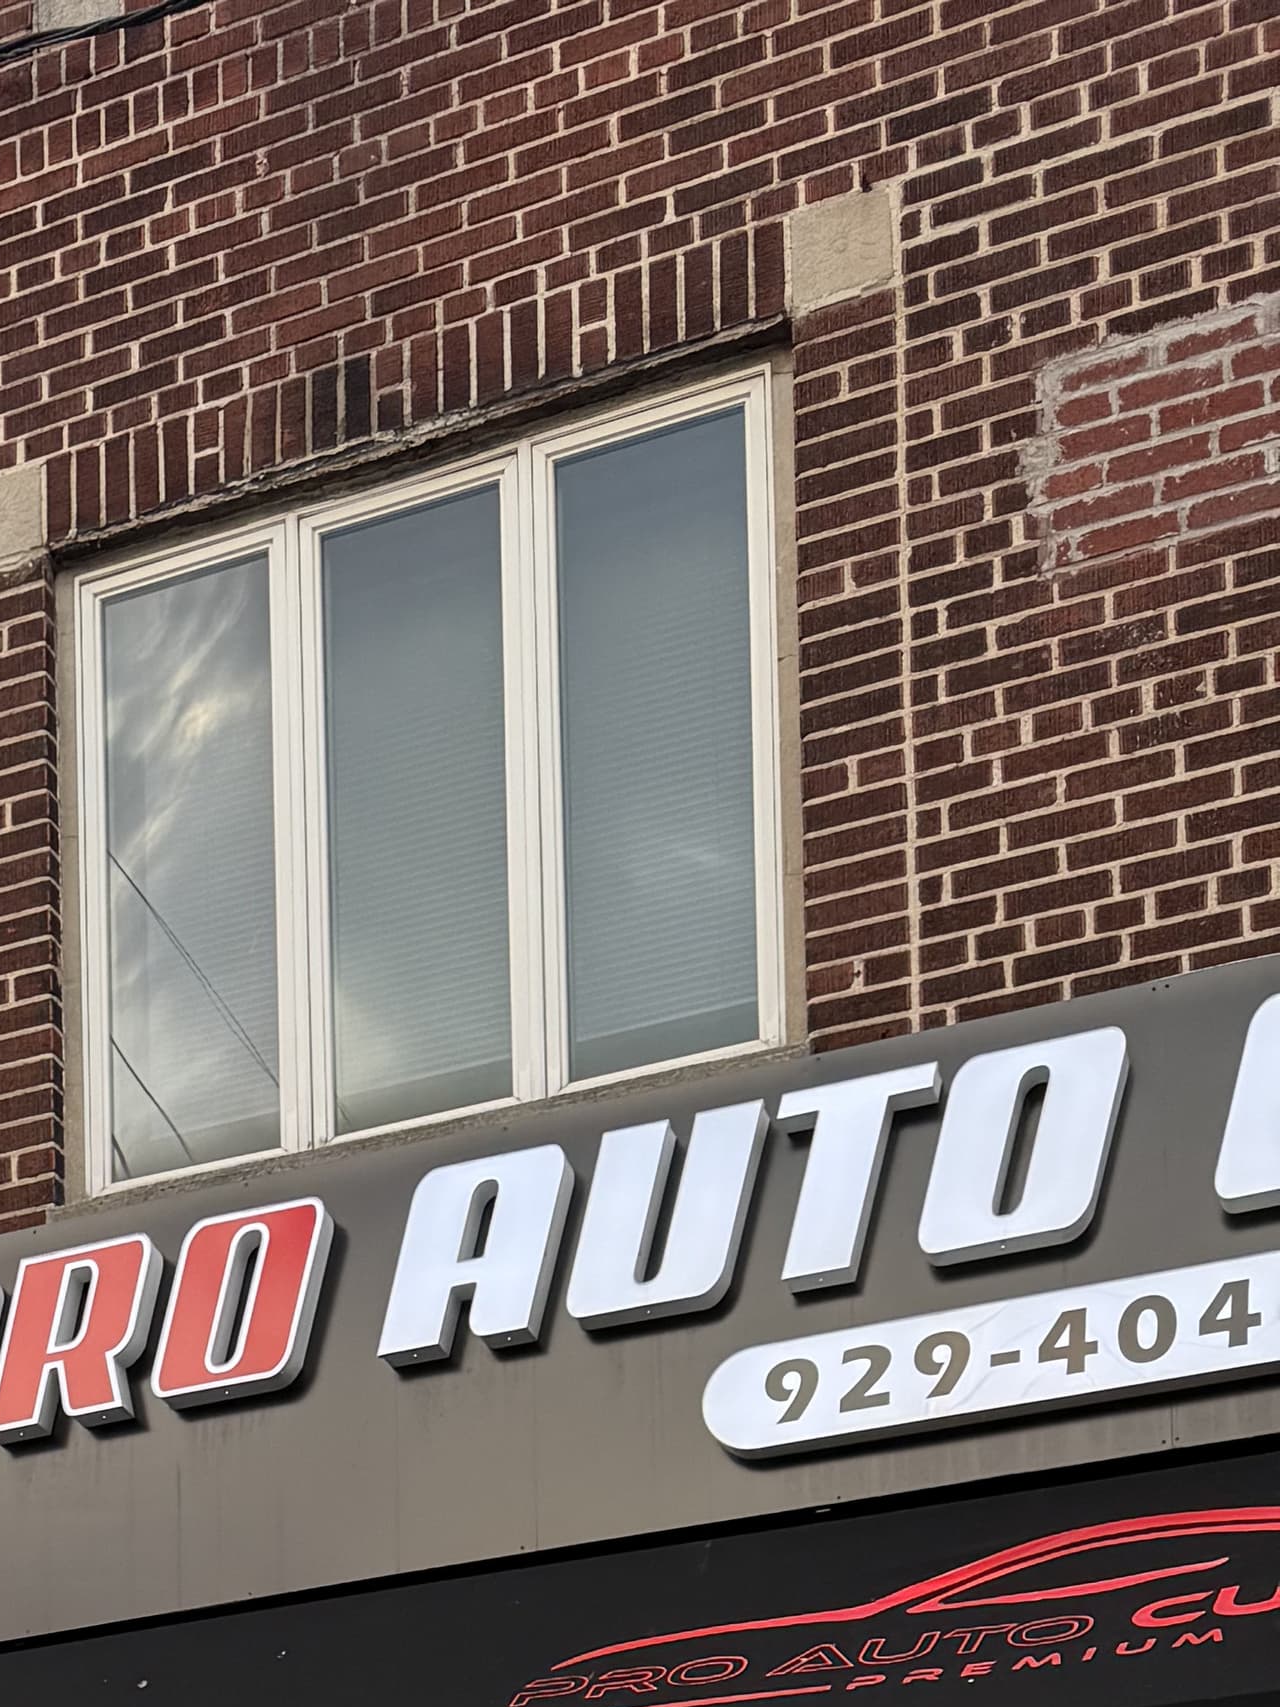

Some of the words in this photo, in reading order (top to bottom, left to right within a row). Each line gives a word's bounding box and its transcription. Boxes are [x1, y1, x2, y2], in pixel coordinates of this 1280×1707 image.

[378, 1026, 1128, 1366] AUTO
[510, 1656, 749, 1707] PRO
[767, 1614, 1095, 1677] AUTO
[845, 1628, 1224, 1690] PREMIUM
